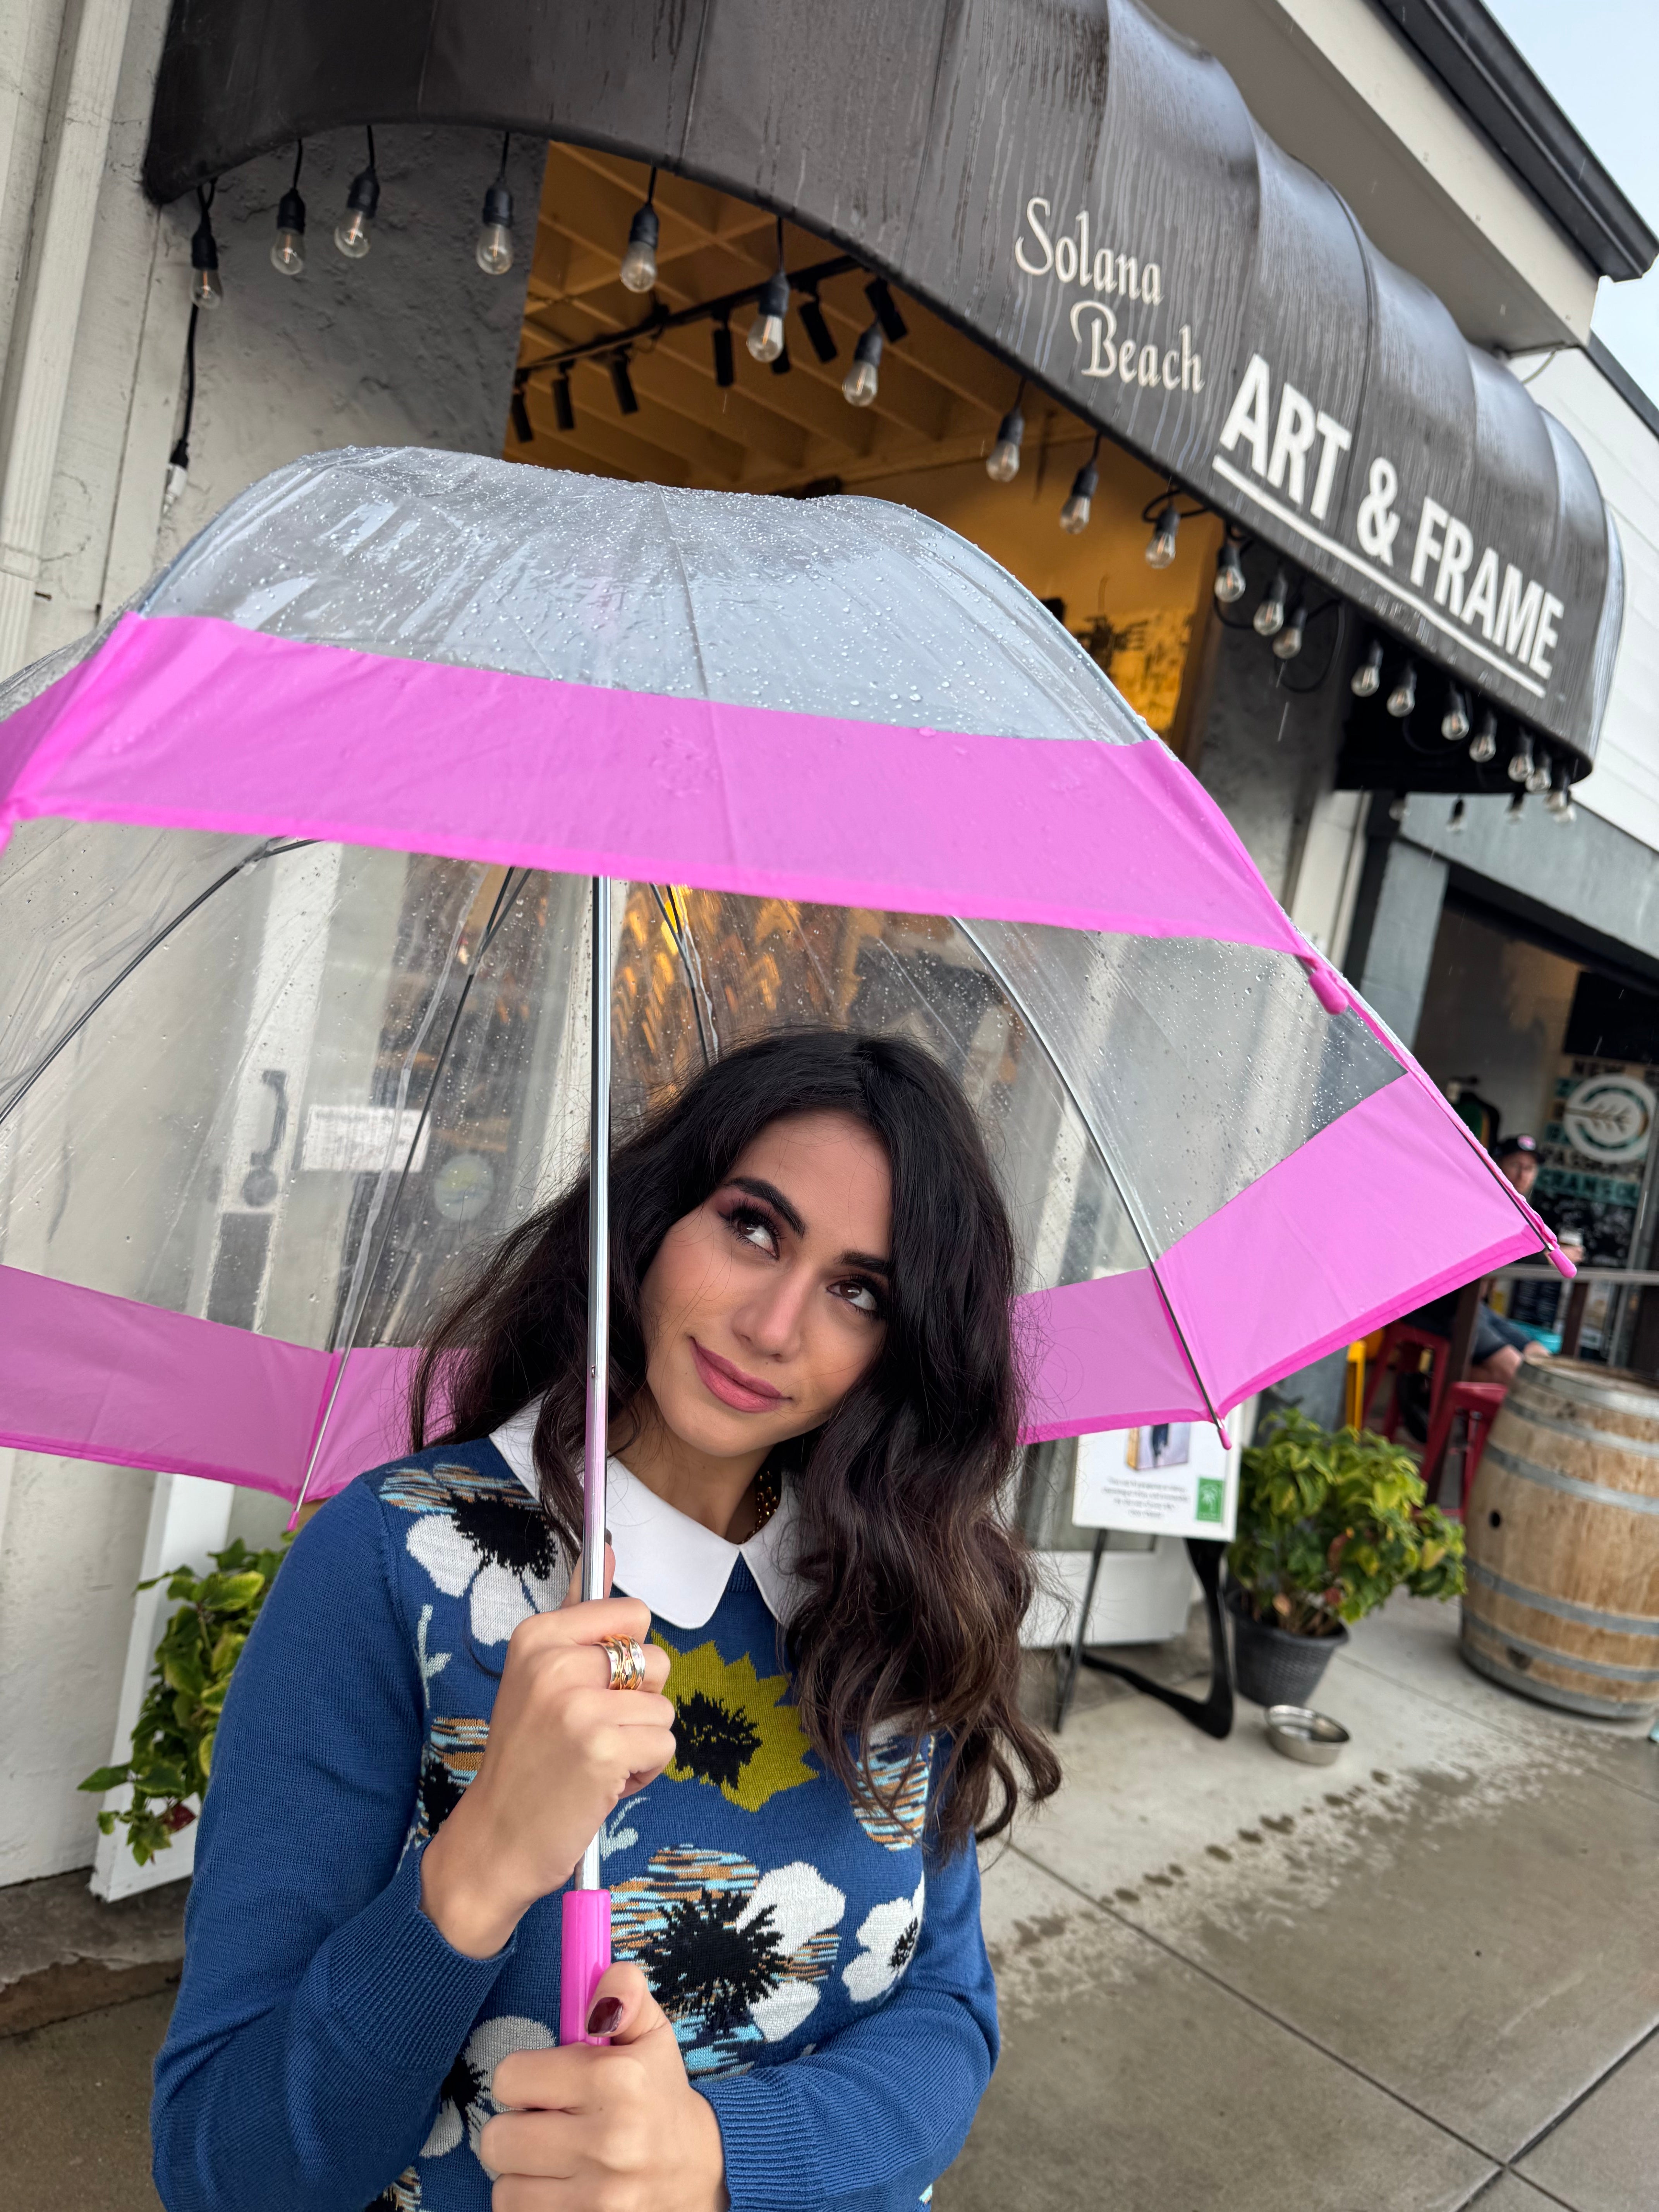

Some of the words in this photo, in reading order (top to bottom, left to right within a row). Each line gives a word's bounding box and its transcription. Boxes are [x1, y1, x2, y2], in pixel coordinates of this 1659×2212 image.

[1015, 197, 1163, 306] Solana
[1070, 300, 1205, 393] Beach
[1219, 354, 1352, 520] ART
[1357, 457, 1400, 567] &
[1411, 496, 1564, 679] FRAME
